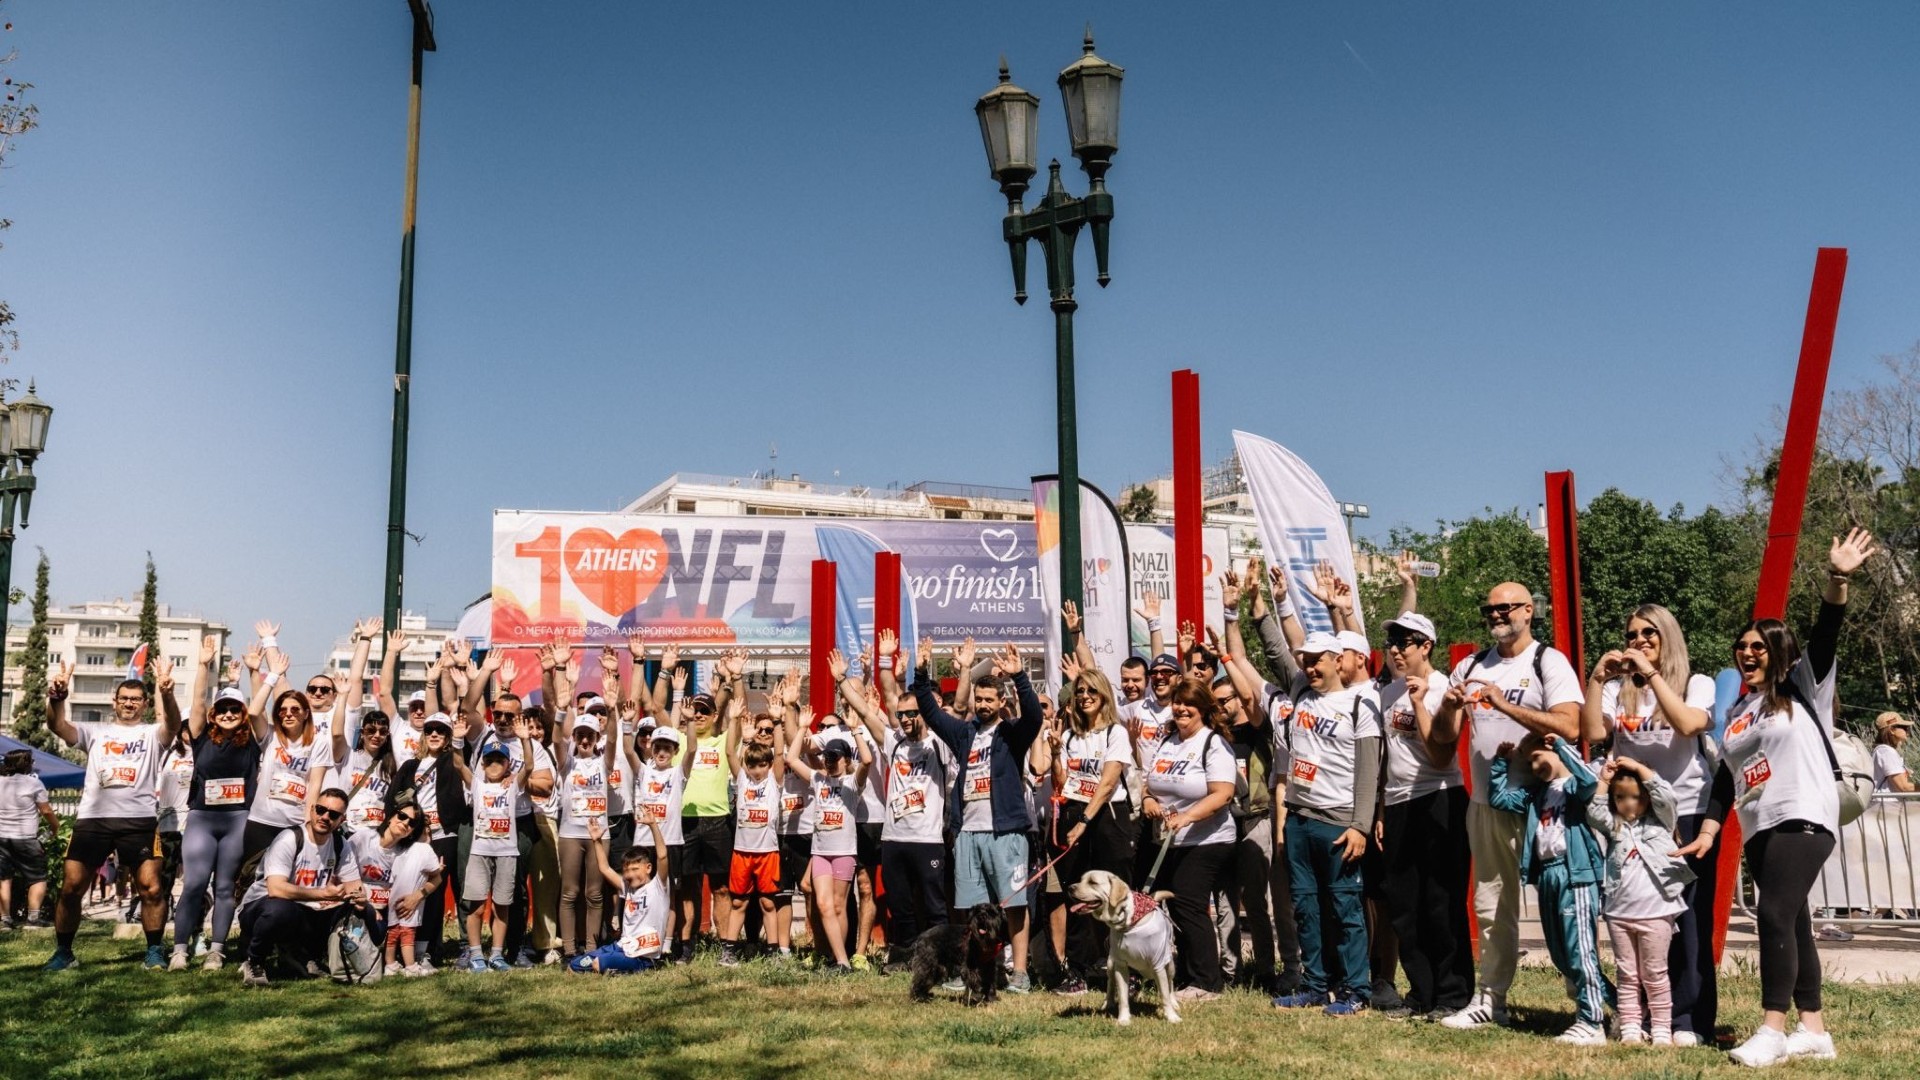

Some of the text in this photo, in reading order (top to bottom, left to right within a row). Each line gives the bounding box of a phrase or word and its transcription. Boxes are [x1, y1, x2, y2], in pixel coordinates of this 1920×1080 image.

[575, 548, 658, 572] ATHENS
[1132, 552, 1168, 571] ΜΑΖΙ
[638, 528, 796, 618] NFL
[938, 564, 1026, 608] finish
[969, 602, 1025, 613] ATHENS
[933, 626, 974, 636] ΠΕΔΙΟΝ
[976, 626, 996, 636] ΤΟΥ
[1314, 716, 1340, 738] NFL
[122, 739, 148, 755] NFL
[1163, 760, 1190, 776] NFL
[1294, 760, 1316, 774] 7087
[1745, 761, 1769, 783] 7148
[585, 772, 603, 787] NFL
[225, 785, 243, 795] 7161
[288, 783, 306, 795] 7108
[751, 810, 767, 818] 7146
[825, 812, 842, 821] 7147
[492, 820, 509, 828] 7132
